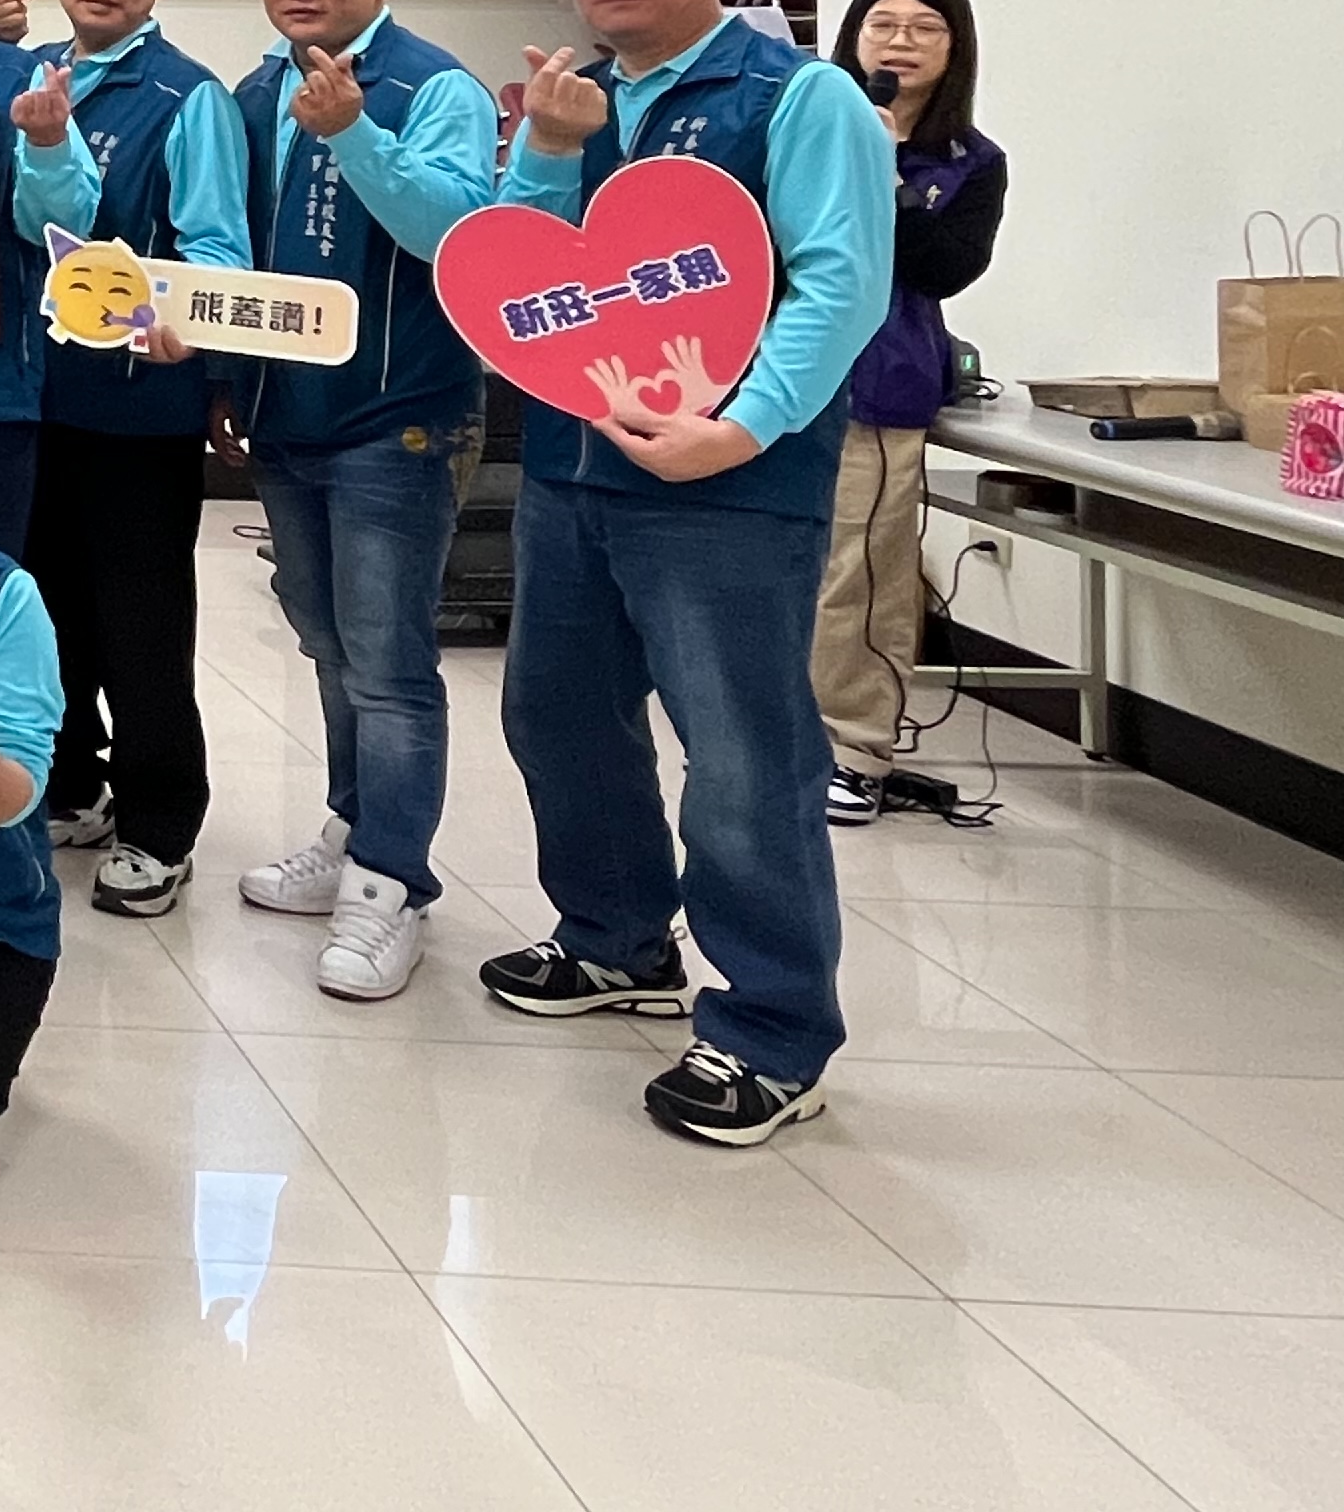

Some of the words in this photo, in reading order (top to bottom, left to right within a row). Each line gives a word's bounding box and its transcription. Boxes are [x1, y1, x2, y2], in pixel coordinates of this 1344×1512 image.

[502, 247, 727, 338] 新莊一家親
